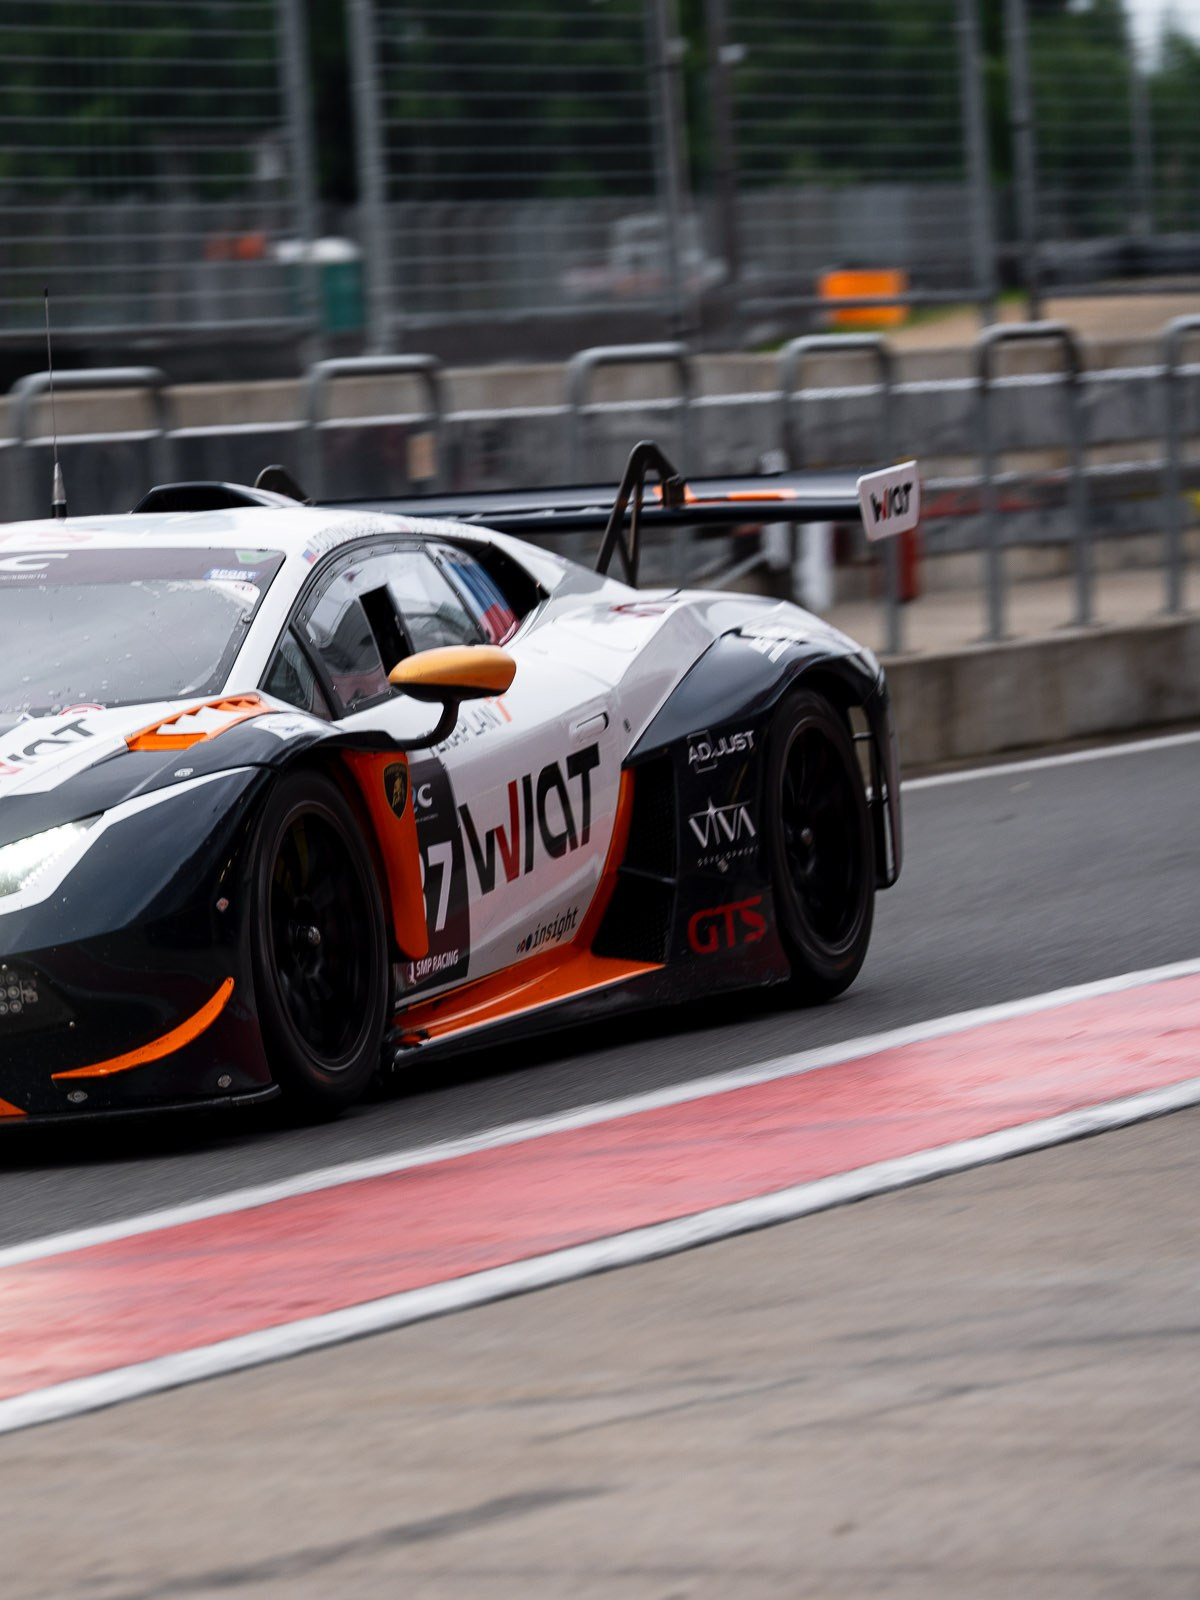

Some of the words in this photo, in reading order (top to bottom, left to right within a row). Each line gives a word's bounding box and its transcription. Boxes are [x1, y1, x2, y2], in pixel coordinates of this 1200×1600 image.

[688, 730, 755, 765] ADJUST
[456, 741, 601, 896] WIAT
[687, 803, 757, 849] VIVA
[409, 841, 453, 932] 7
[532, 906, 579, 949] insight
[687, 896, 767, 954] GTS
[416, 957, 432, 977] SMP
[432, 949, 460, 971] RACING
